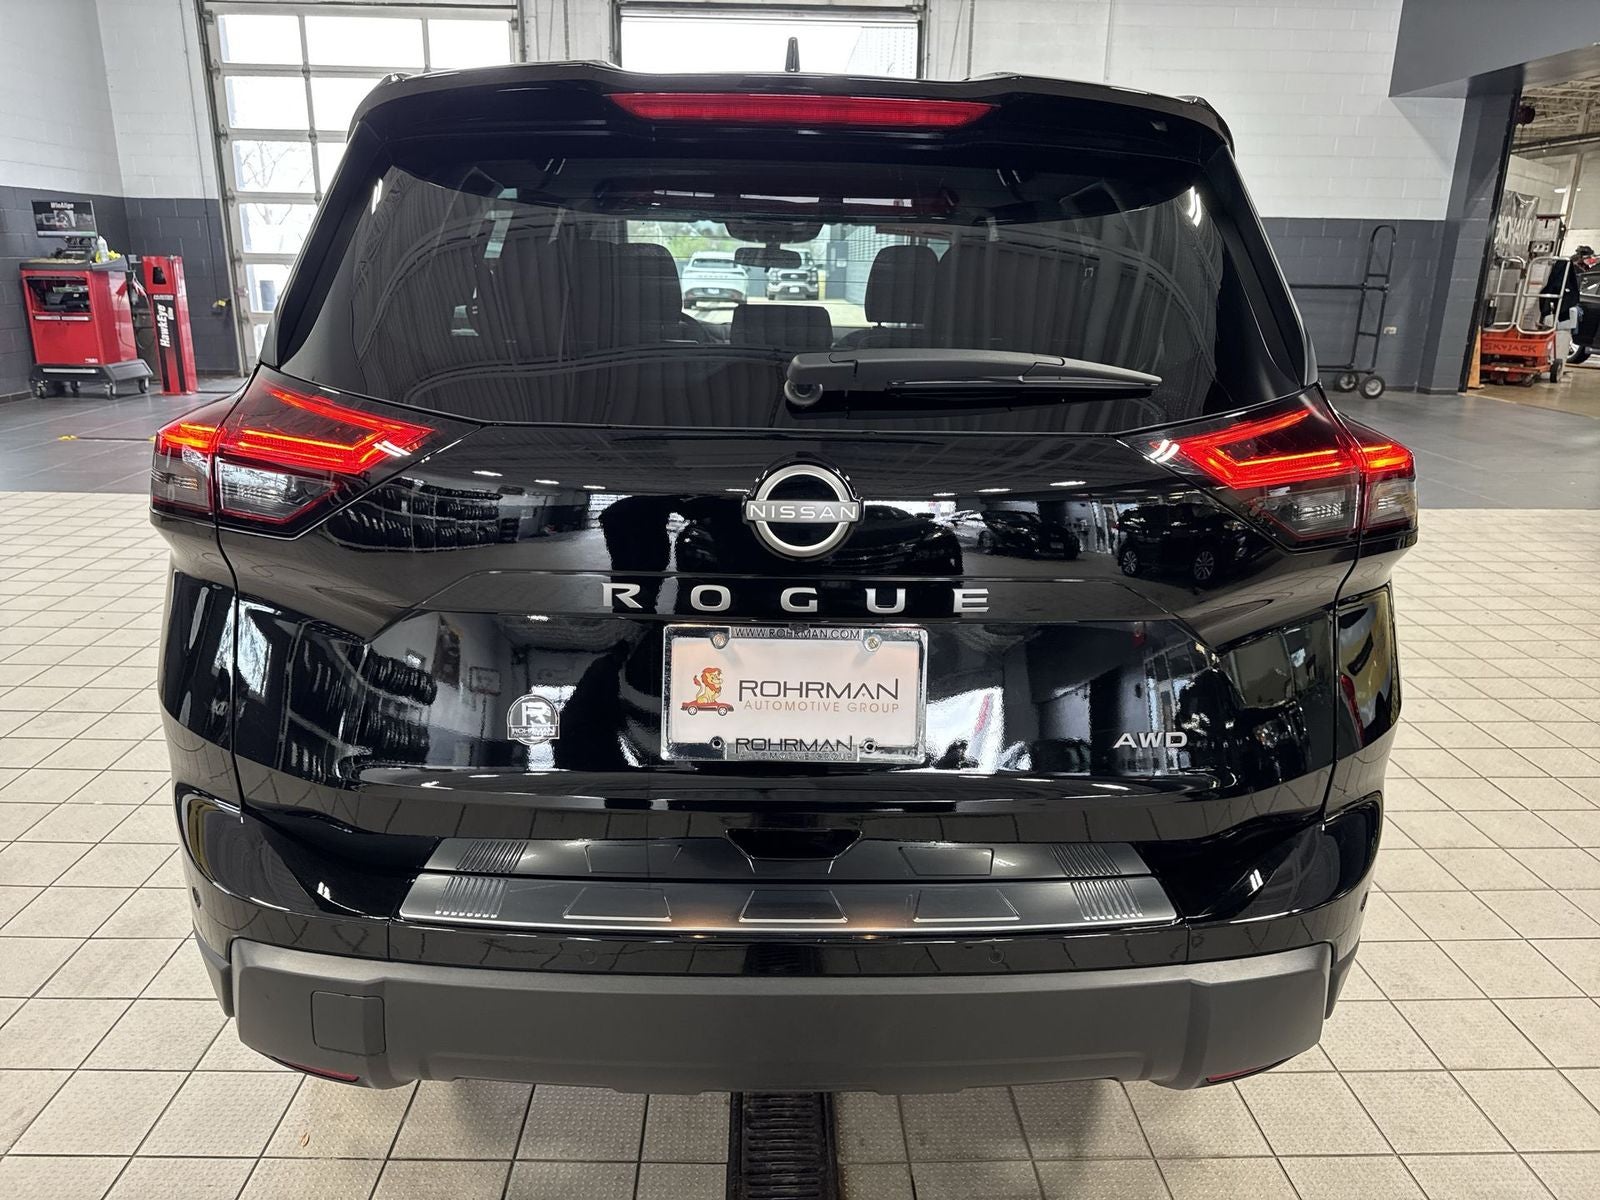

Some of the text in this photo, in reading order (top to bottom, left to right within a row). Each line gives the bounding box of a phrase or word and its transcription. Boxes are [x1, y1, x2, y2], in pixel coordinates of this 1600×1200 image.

[1483, 342, 1537, 353] SKYJACK
[750, 504, 857, 519] NISSAN
[600, 582, 990, 614] ROGUE
[738, 678, 899, 702] ROHRMAN
[743, 700, 899, 713] AUTOMOTIVE GROUP
[735, 735, 853, 753] ROHRMAN
[1112, 731, 1188, 749] AWD
